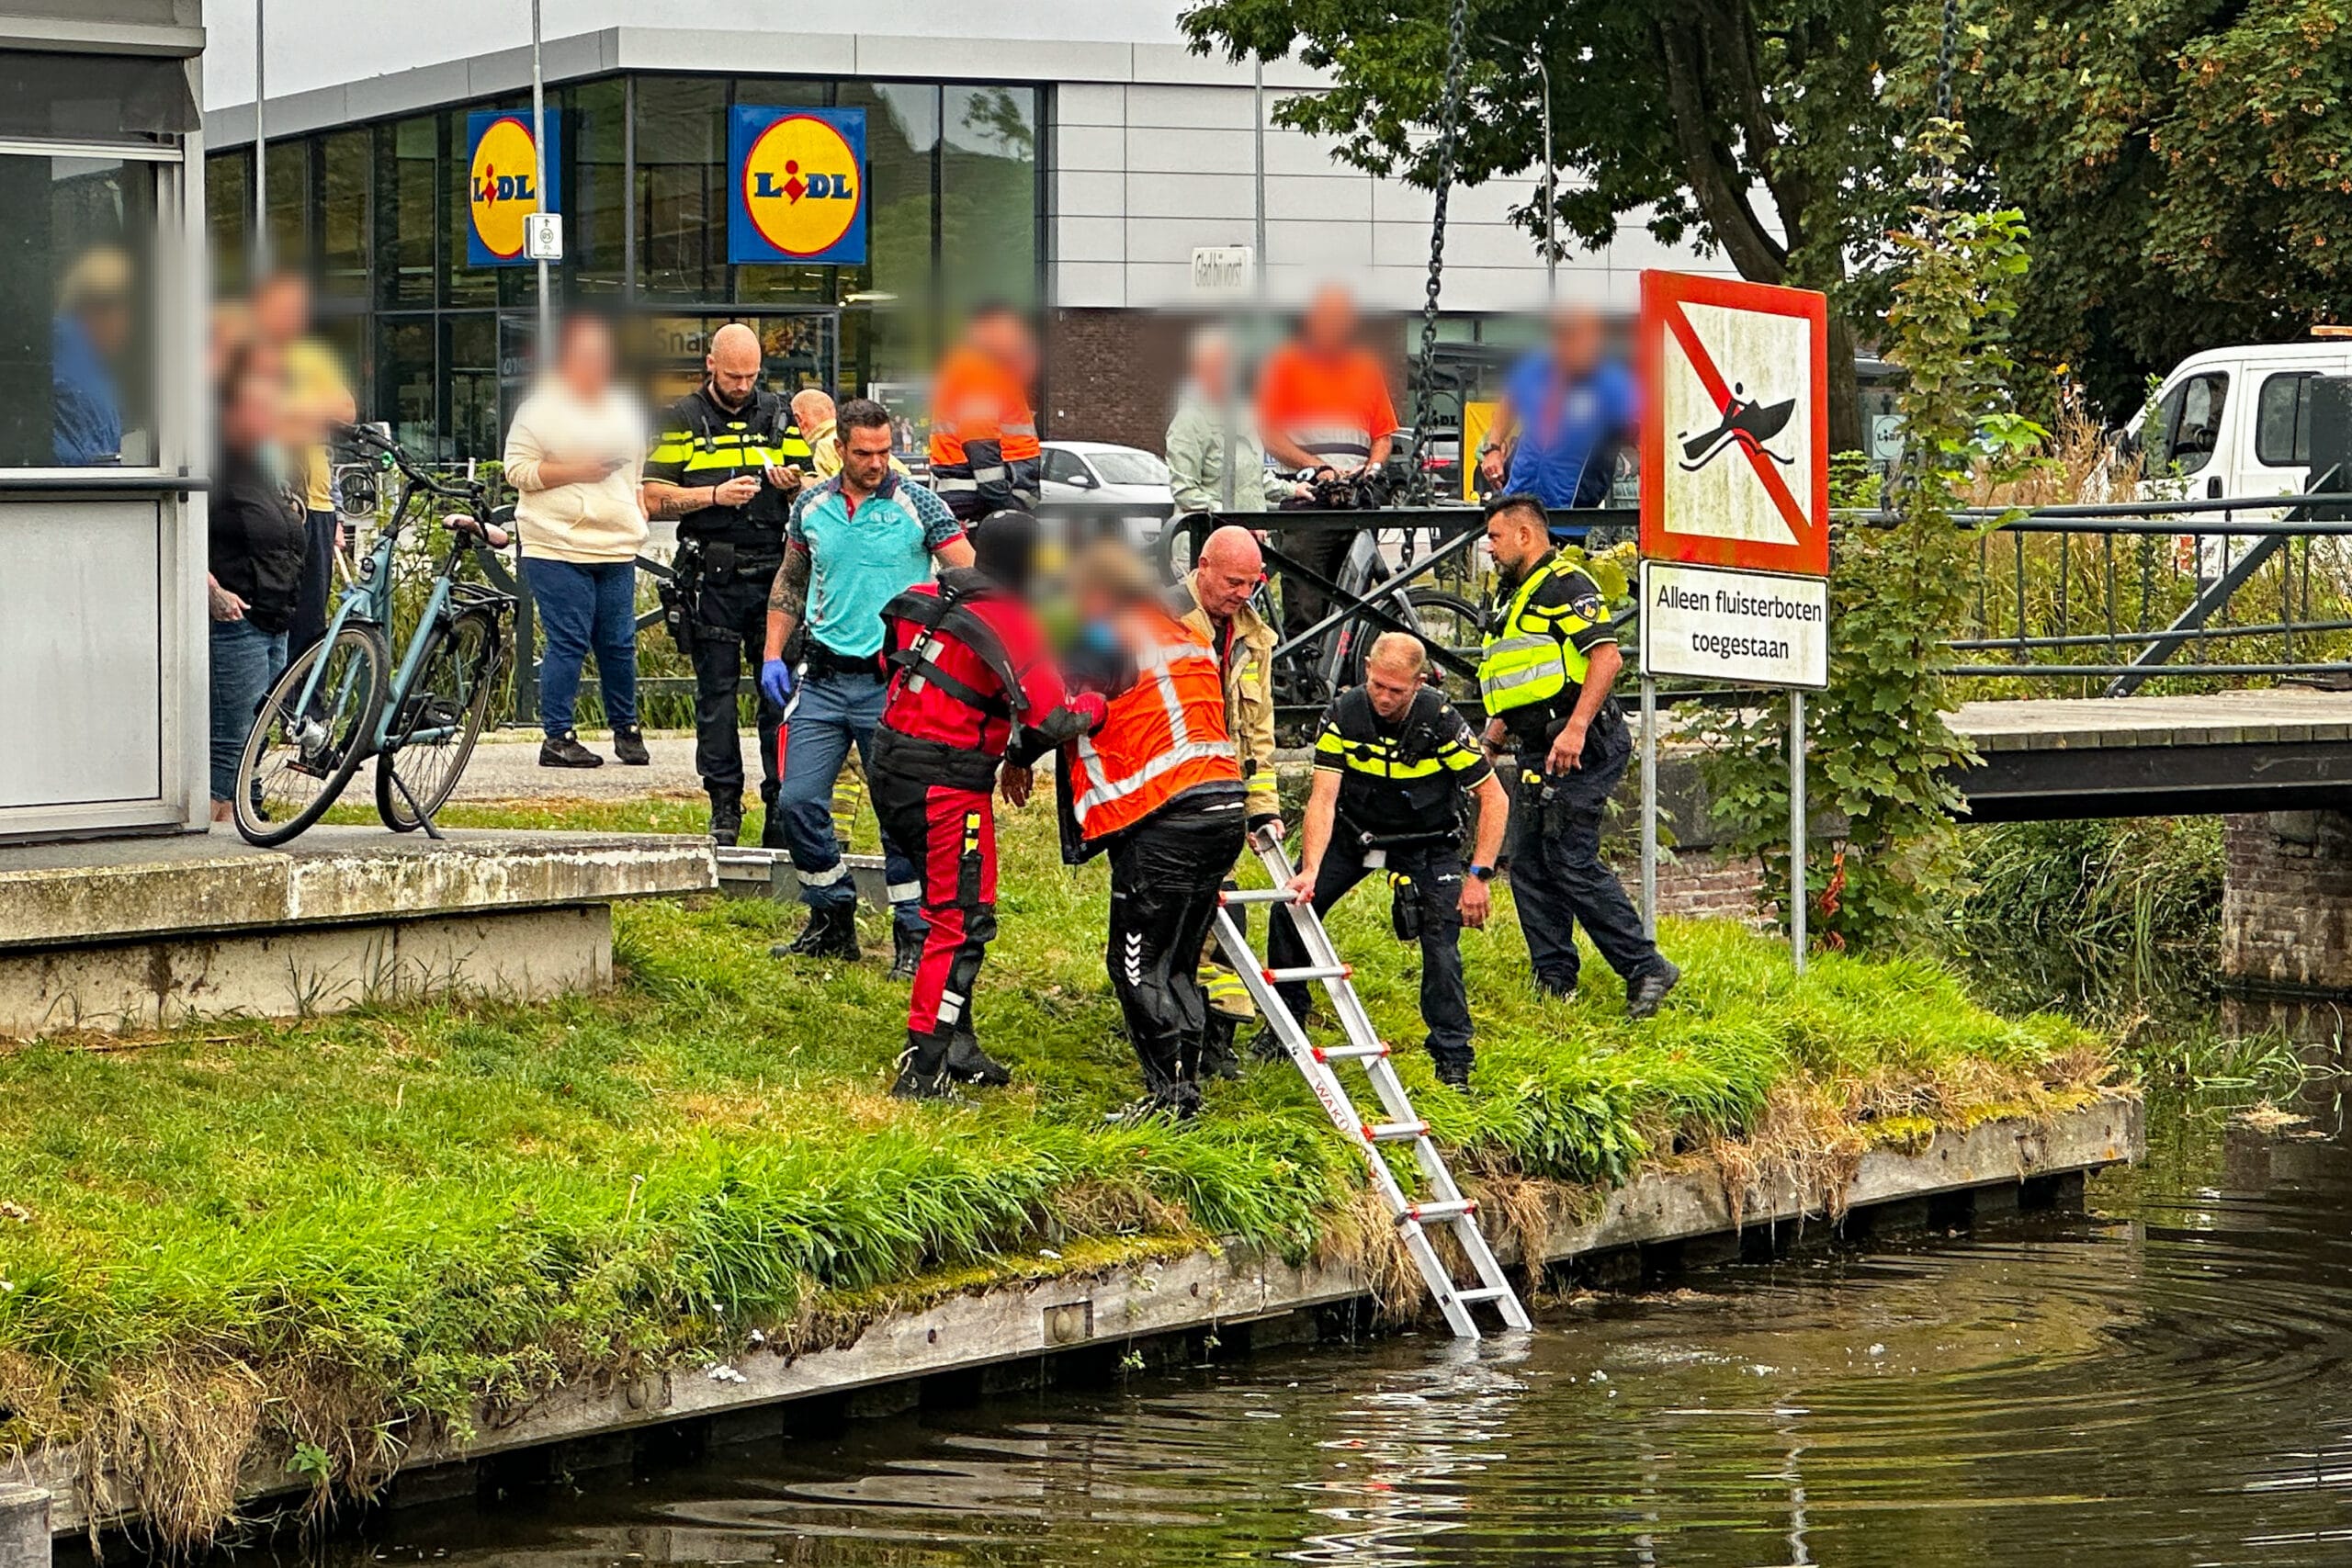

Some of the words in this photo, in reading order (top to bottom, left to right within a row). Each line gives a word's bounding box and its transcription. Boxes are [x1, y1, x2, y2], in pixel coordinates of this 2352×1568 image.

[1657, 584, 1709, 612] Alleen
[1715, 590, 1822, 622] fluisterboten
[1691, 631, 1789, 660] toegestaan
